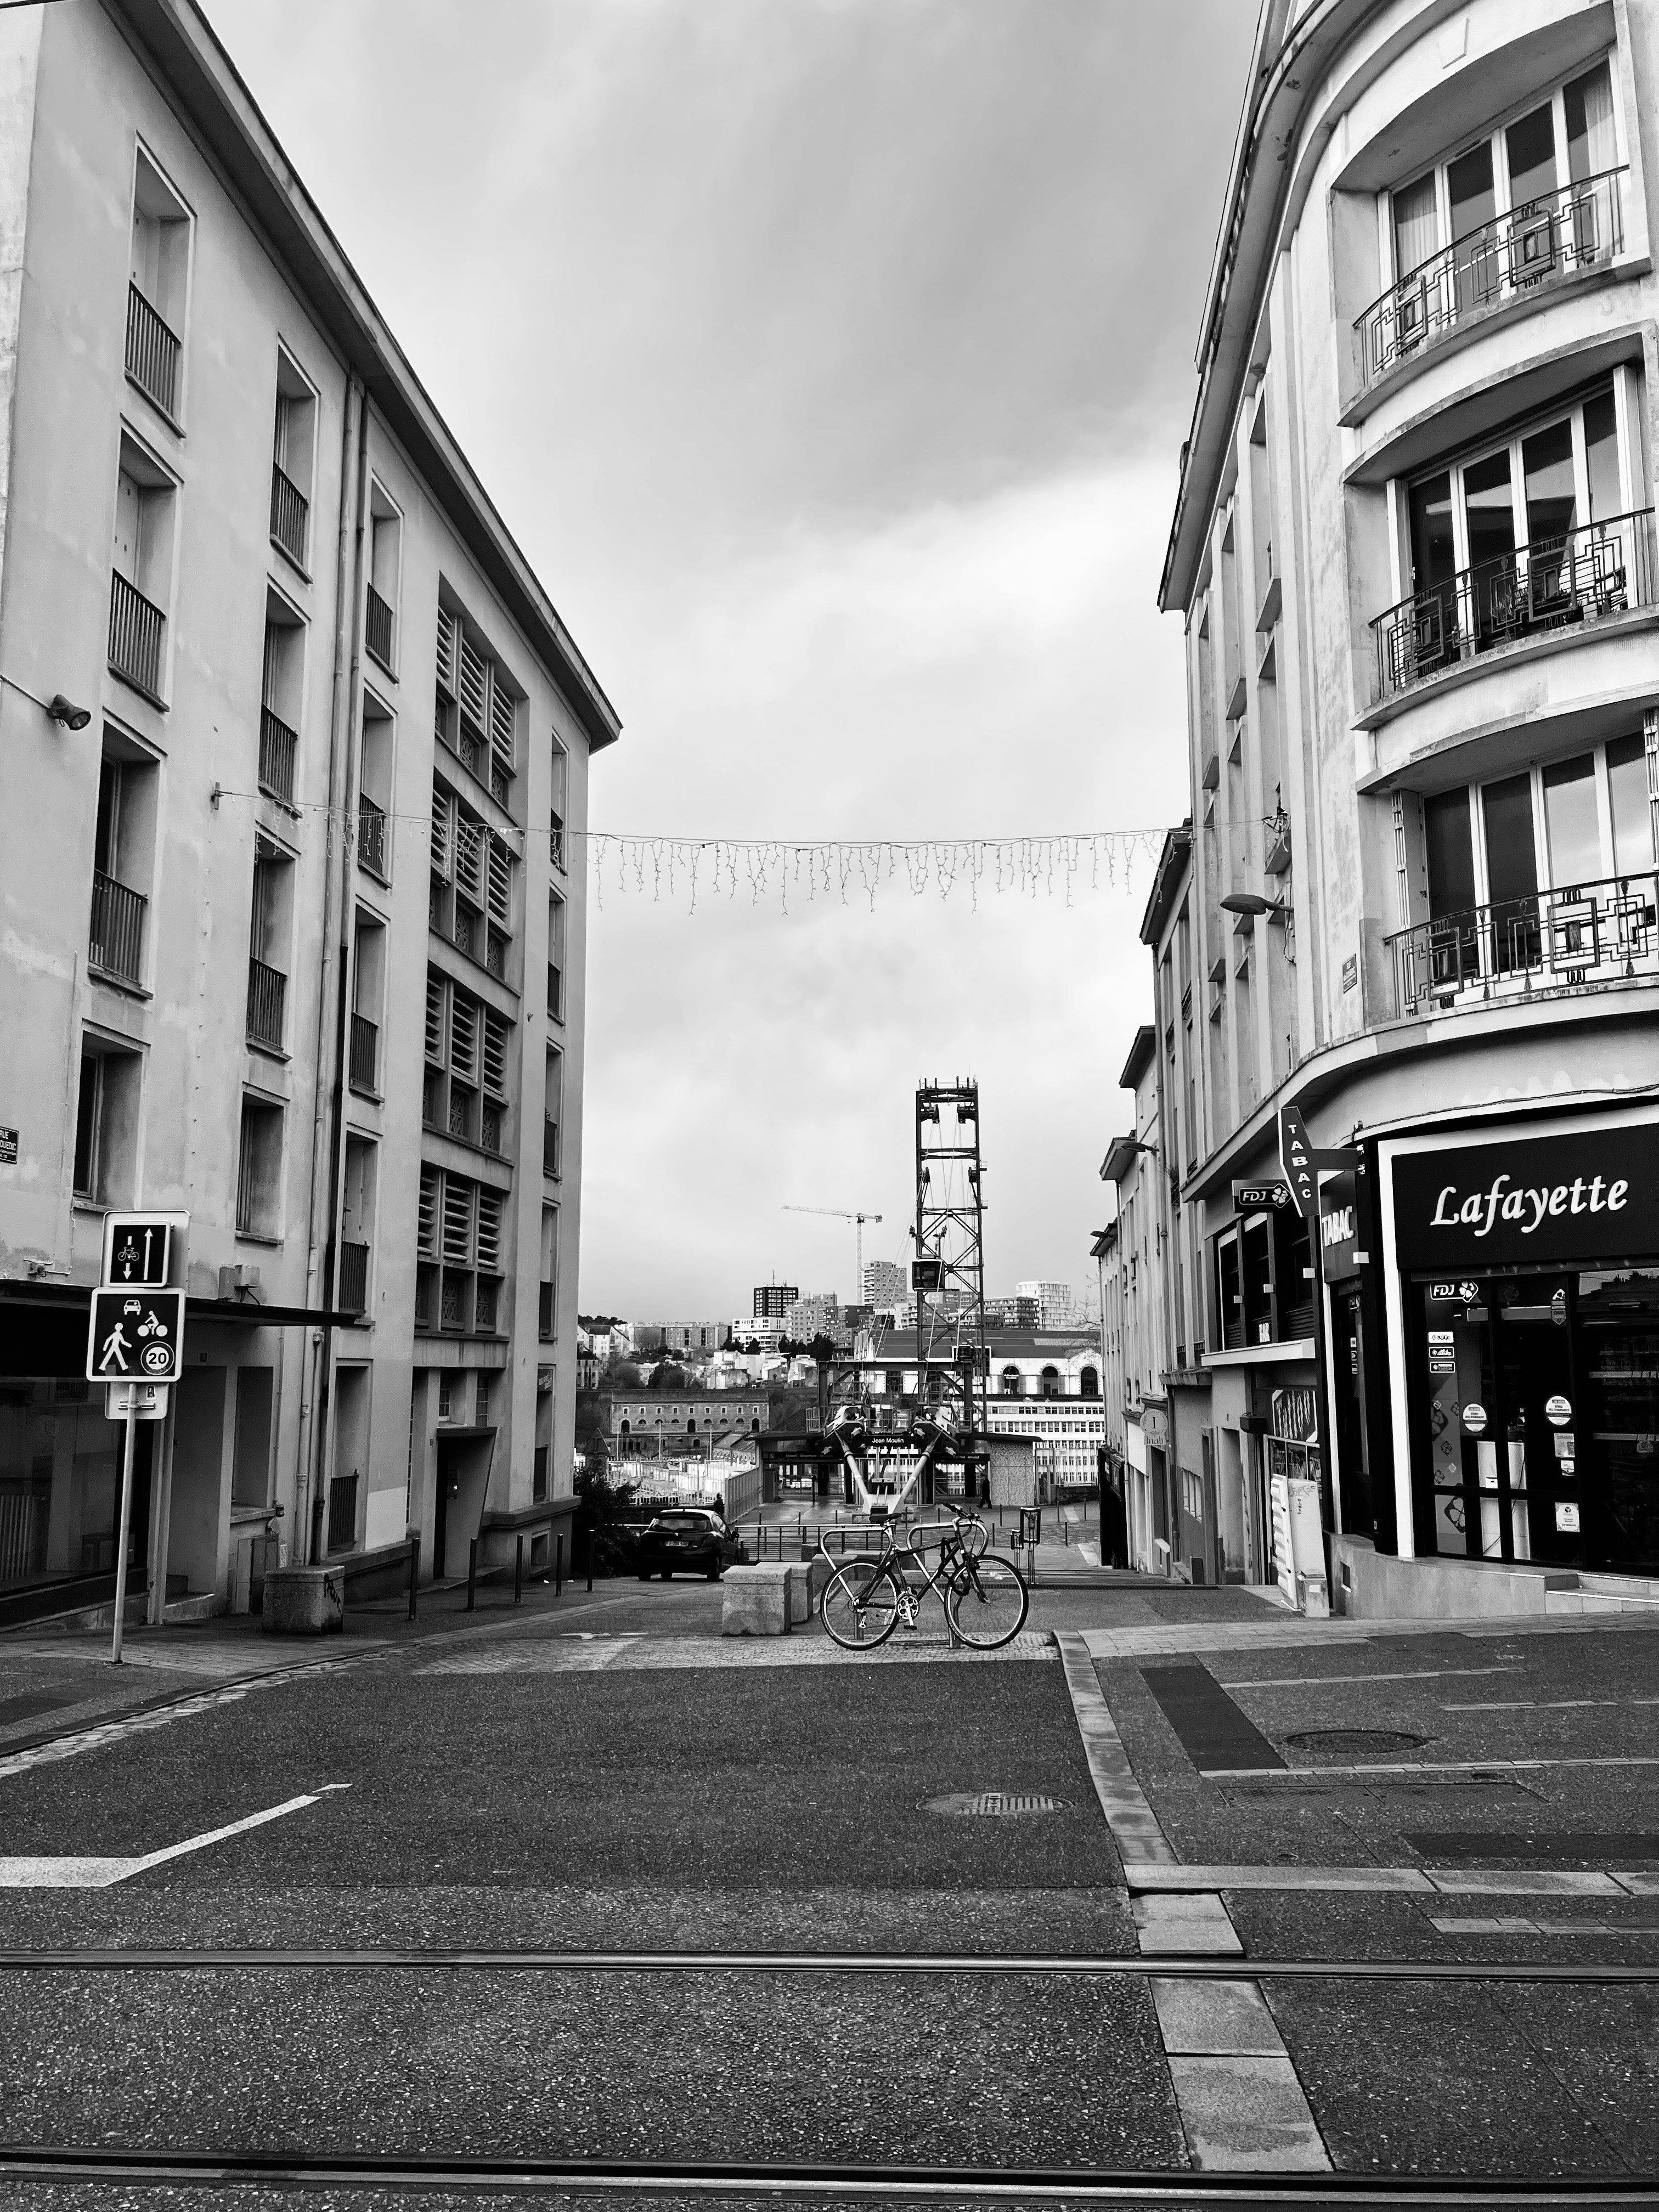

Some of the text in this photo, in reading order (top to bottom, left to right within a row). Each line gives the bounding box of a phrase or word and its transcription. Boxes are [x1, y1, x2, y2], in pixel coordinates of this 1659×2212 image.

[1288, 1124, 1312, 1199] TABAC
[1242, 1191, 1267, 1201] FDJ
[1430, 1174, 1629, 1237] Lafayette
[1321, 1206, 1354, 1247] TABAC
[1433, 1284, 1455, 1296] FDJ
[148, 1352, 167, 1364] 20
